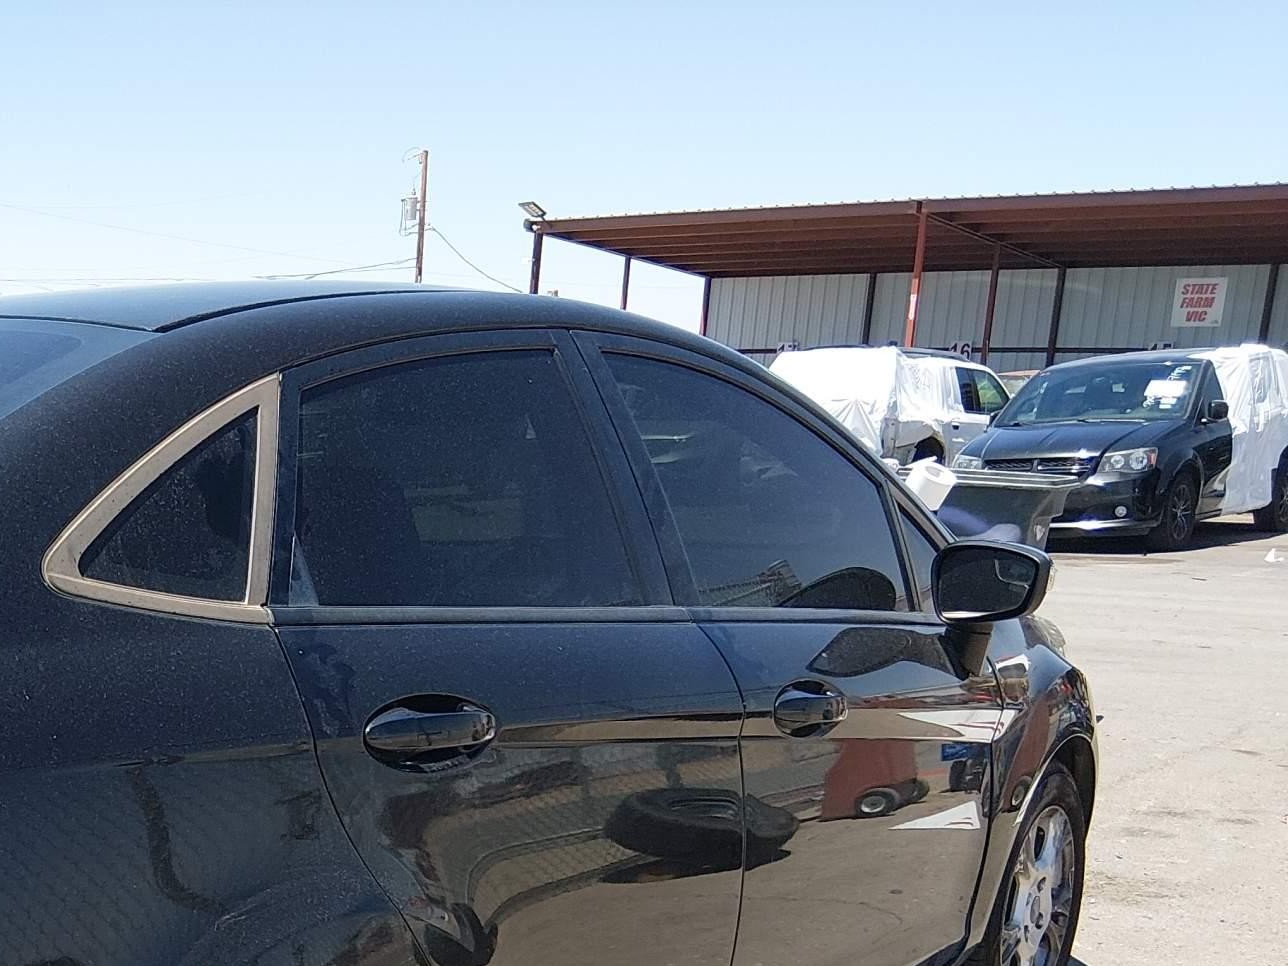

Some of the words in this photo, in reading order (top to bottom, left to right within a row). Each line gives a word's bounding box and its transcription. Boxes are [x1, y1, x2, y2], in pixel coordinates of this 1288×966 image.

[1181, 283, 1219, 295] STATE
[1180, 296, 1216, 309] FARM
[1185, 310, 1208, 322] VIC
